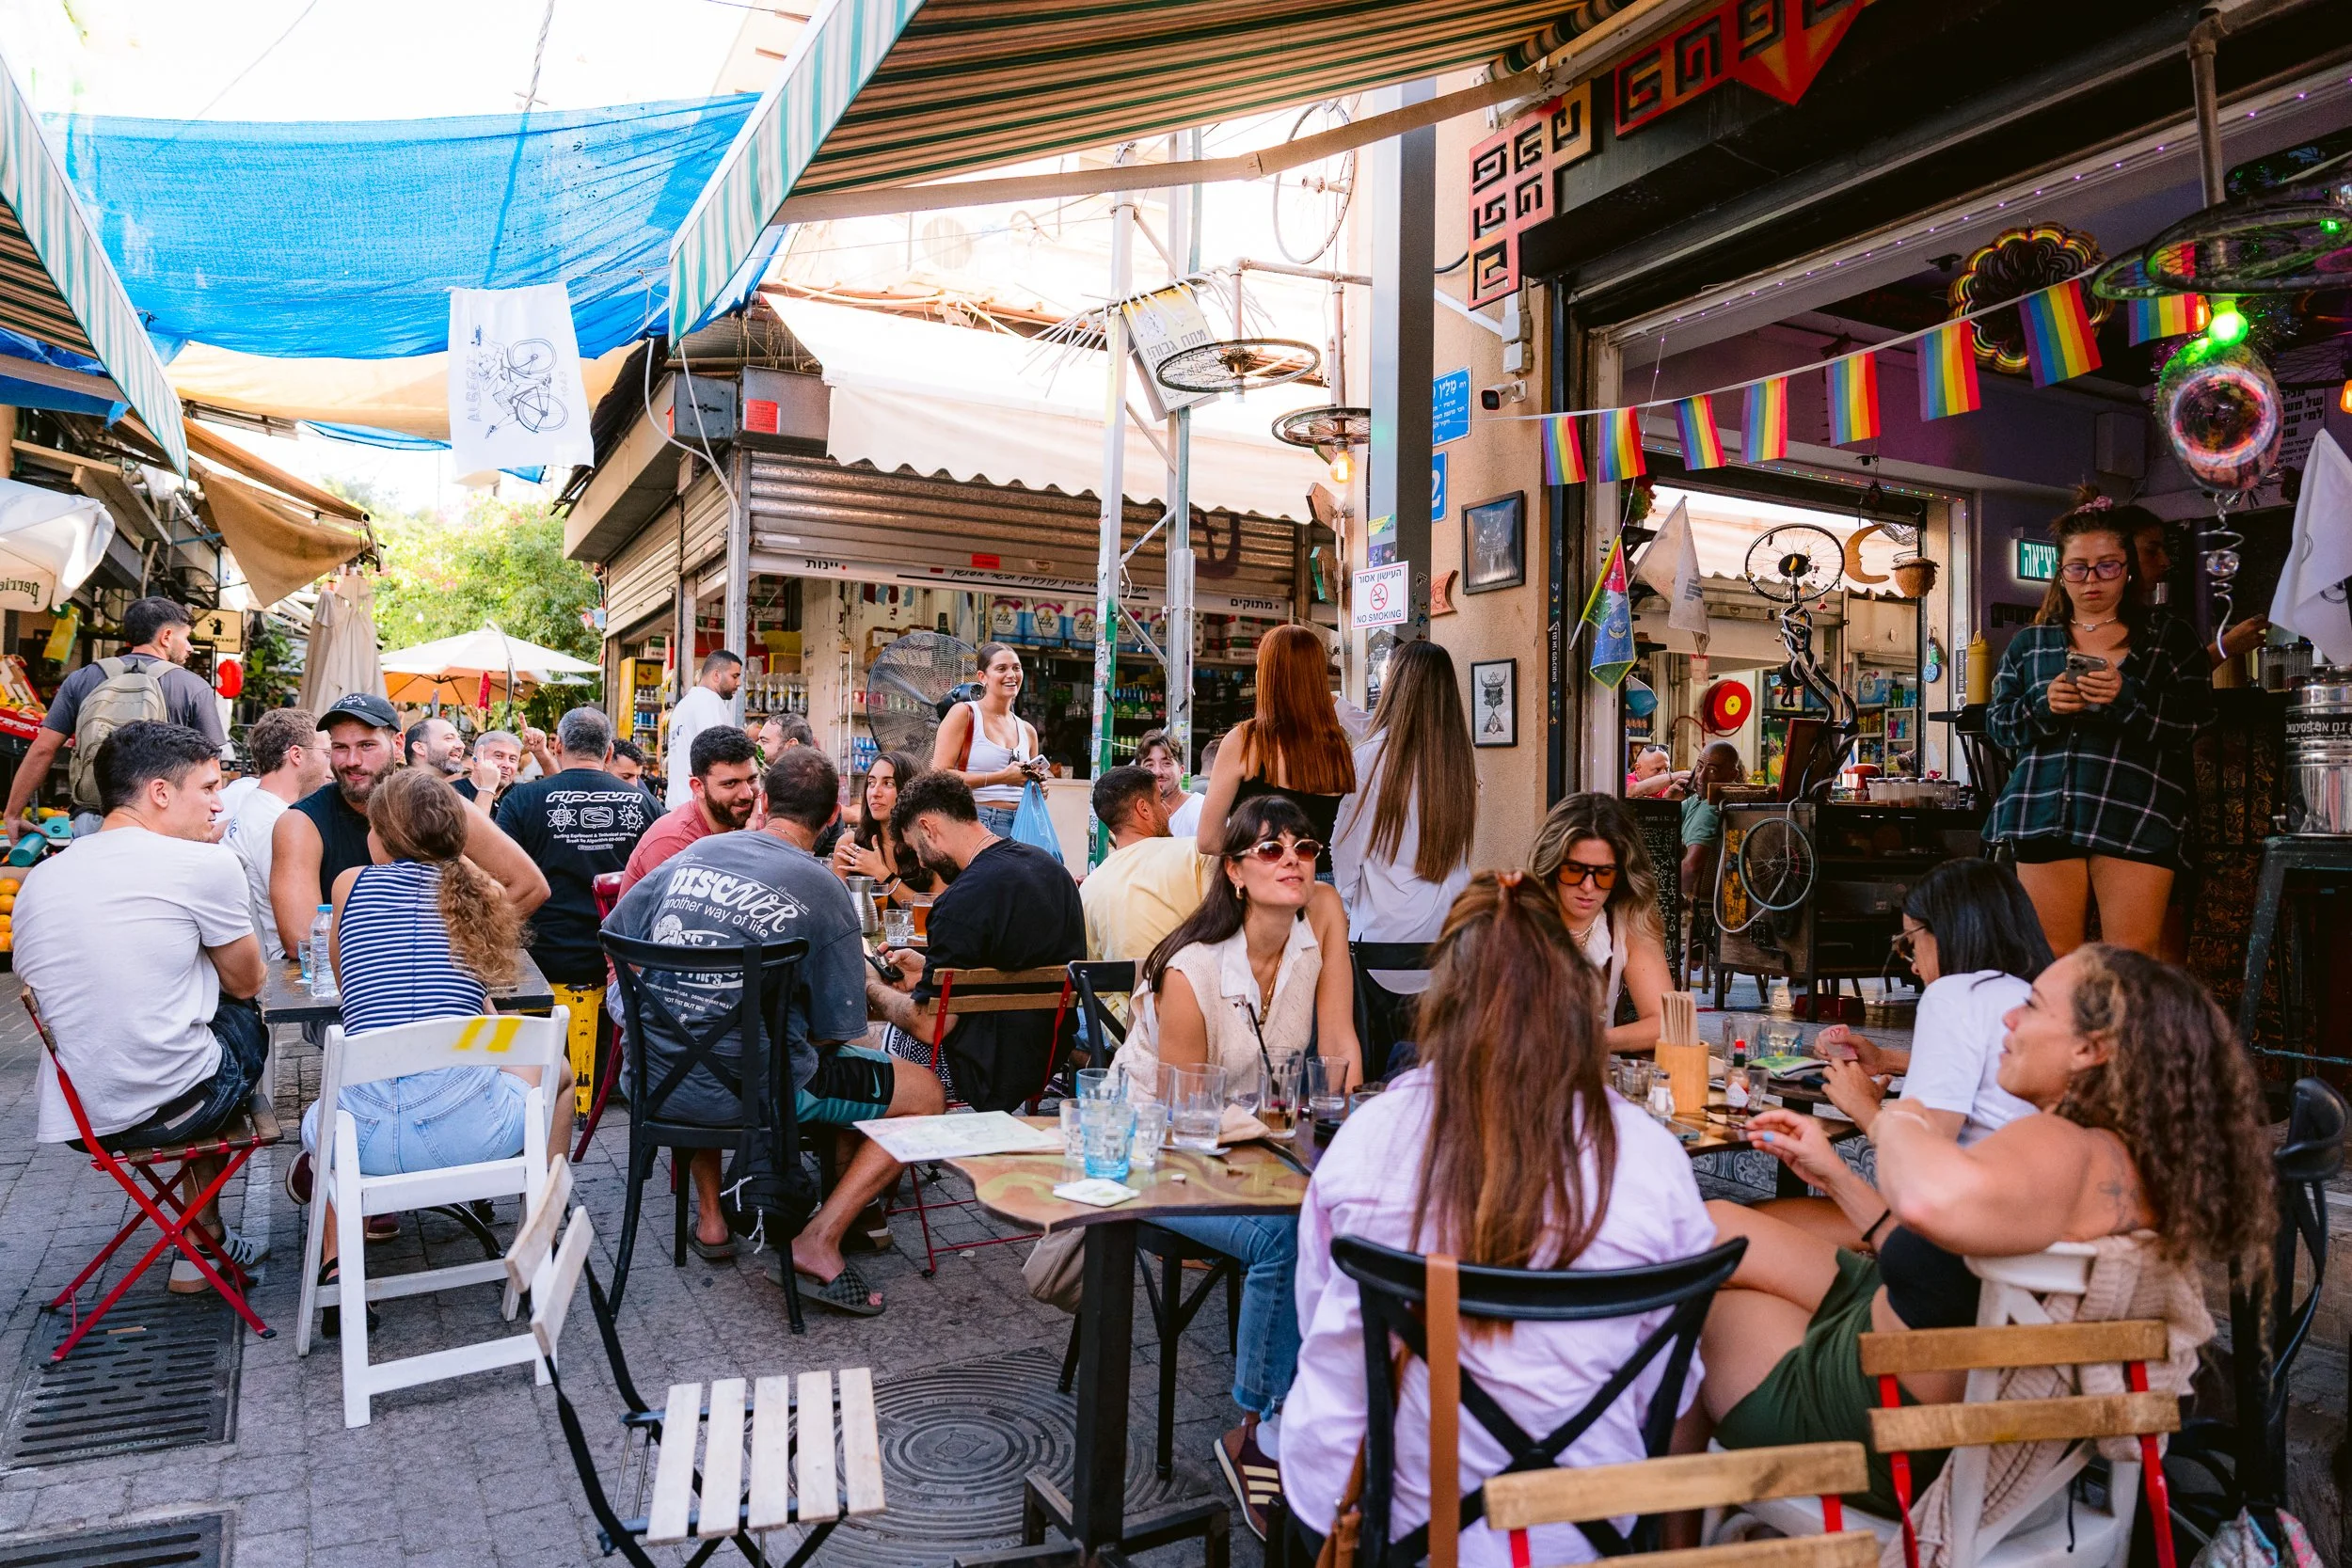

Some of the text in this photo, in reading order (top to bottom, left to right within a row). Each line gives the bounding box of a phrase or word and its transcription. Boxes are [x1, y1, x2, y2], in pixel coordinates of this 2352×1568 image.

[1181, 329, 1207, 347] מתח
[805, 559, 839, 570] יינות
[2024, 543, 2057, 578] יציאה
[1359, 568, 1402, 584] העישון אסור
[1231, 598, 1273, 610] מתוקים
[1357, 609, 1402, 624] NO SMOKING
[666, 867, 799, 933] DISCOVER
[663, 897, 769, 939] another way of life
